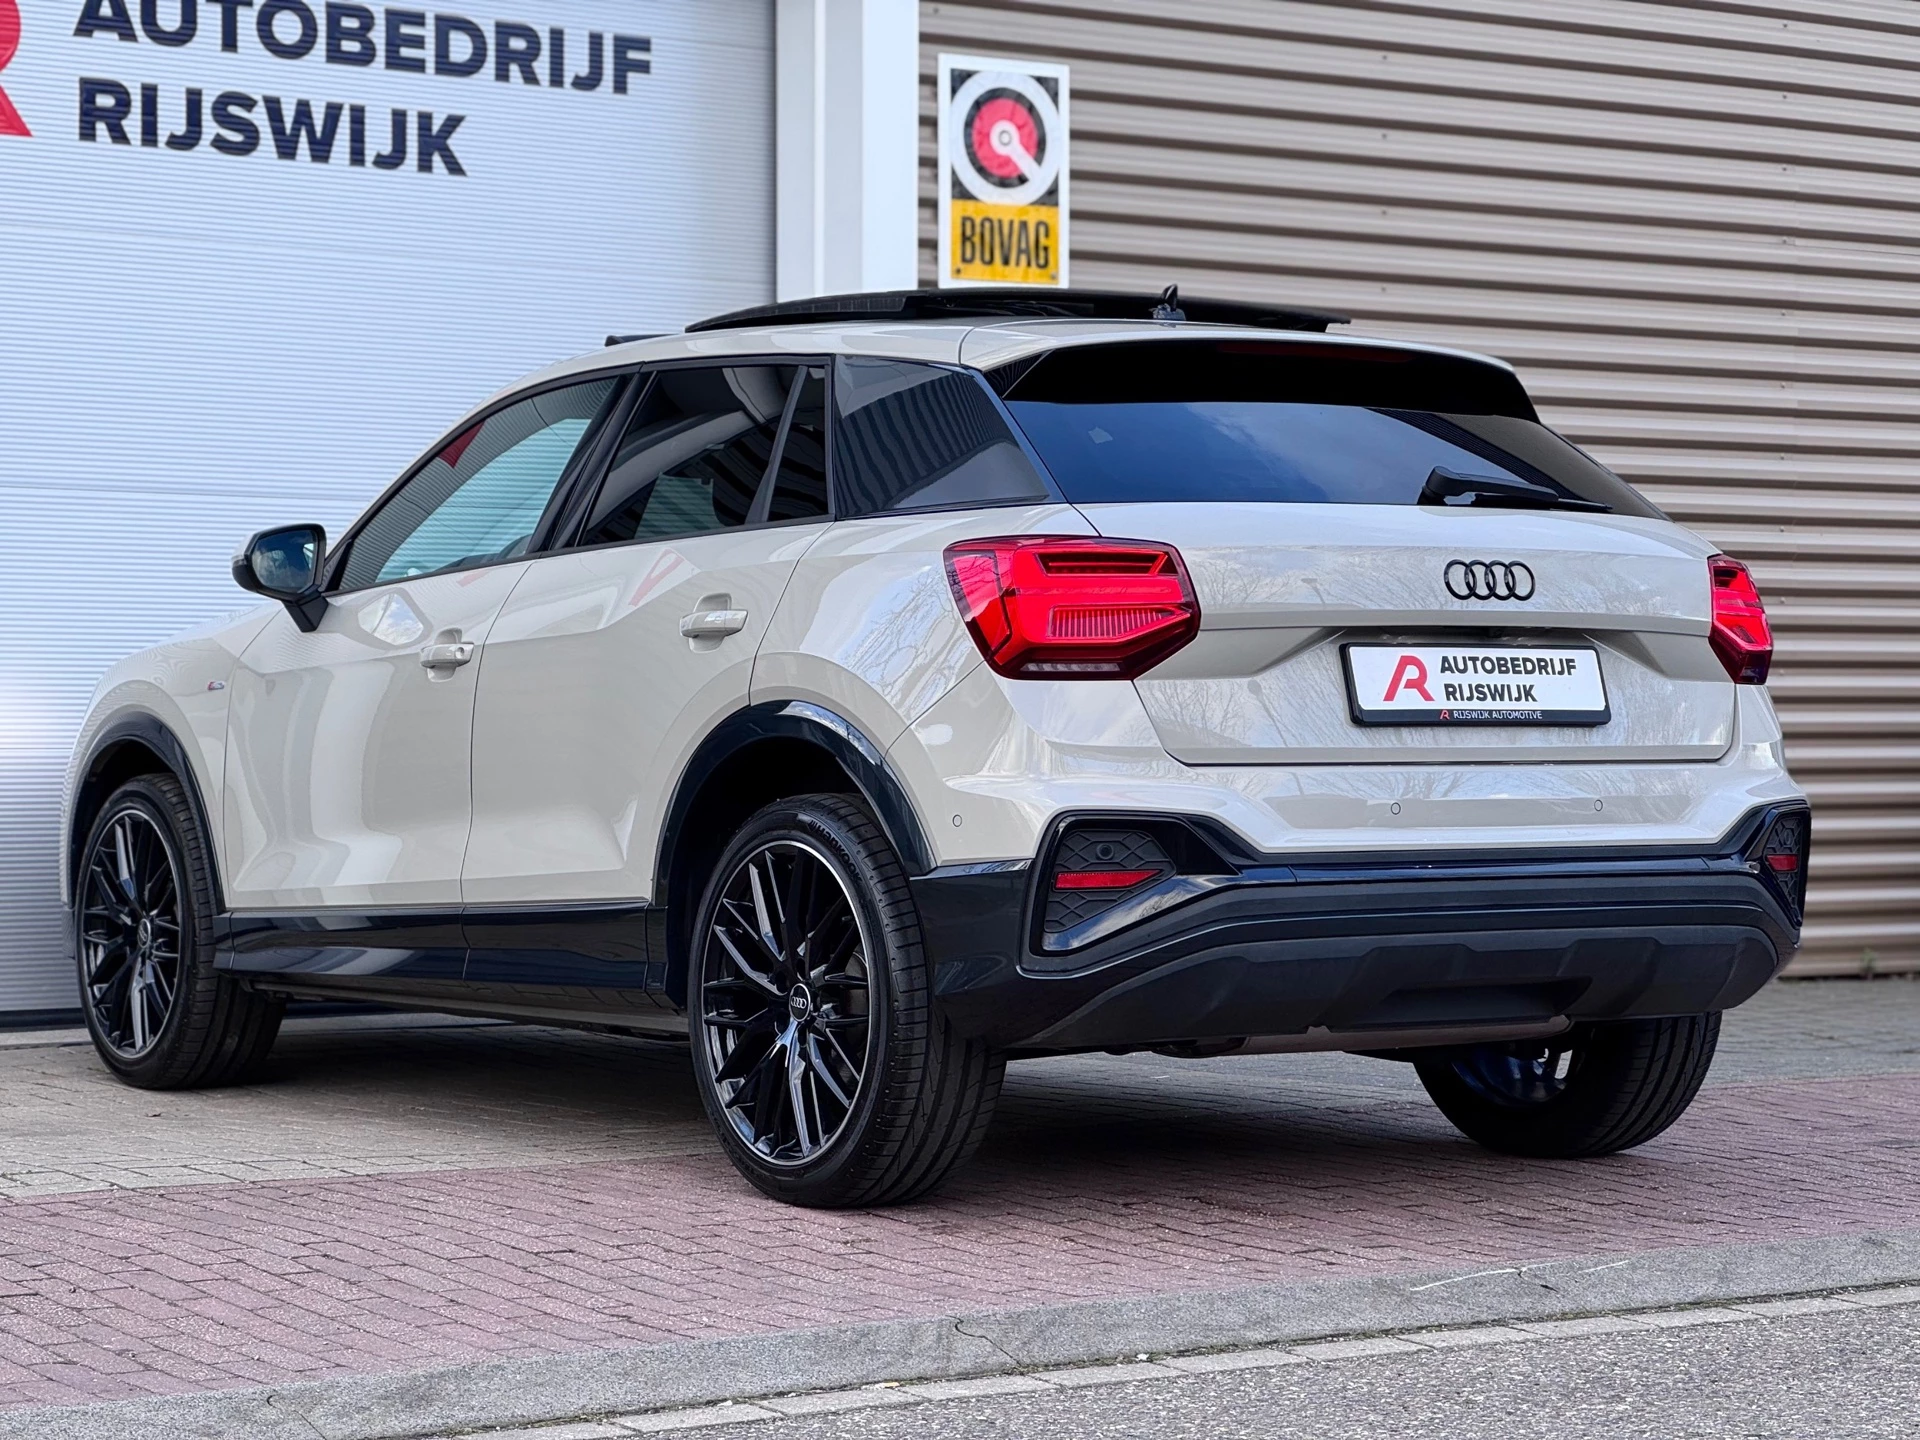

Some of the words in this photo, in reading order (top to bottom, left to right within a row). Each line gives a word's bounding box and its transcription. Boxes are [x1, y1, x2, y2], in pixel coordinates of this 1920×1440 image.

[73, 0, 653, 96] AUTOBEDRIJF
[77, 76, 468, 177] RIJSWIJK
[961, 216, 1050, 269] BOVAG
[1440, 655, 1577, 676] AUTOBEDRIJF
[1444, 683, 1538, 702] RIJSWIJK
[1453, 710, 1490, 719] RIJSWIJK
[1492, 710, 1543, 719] AUTOMOTIVE
